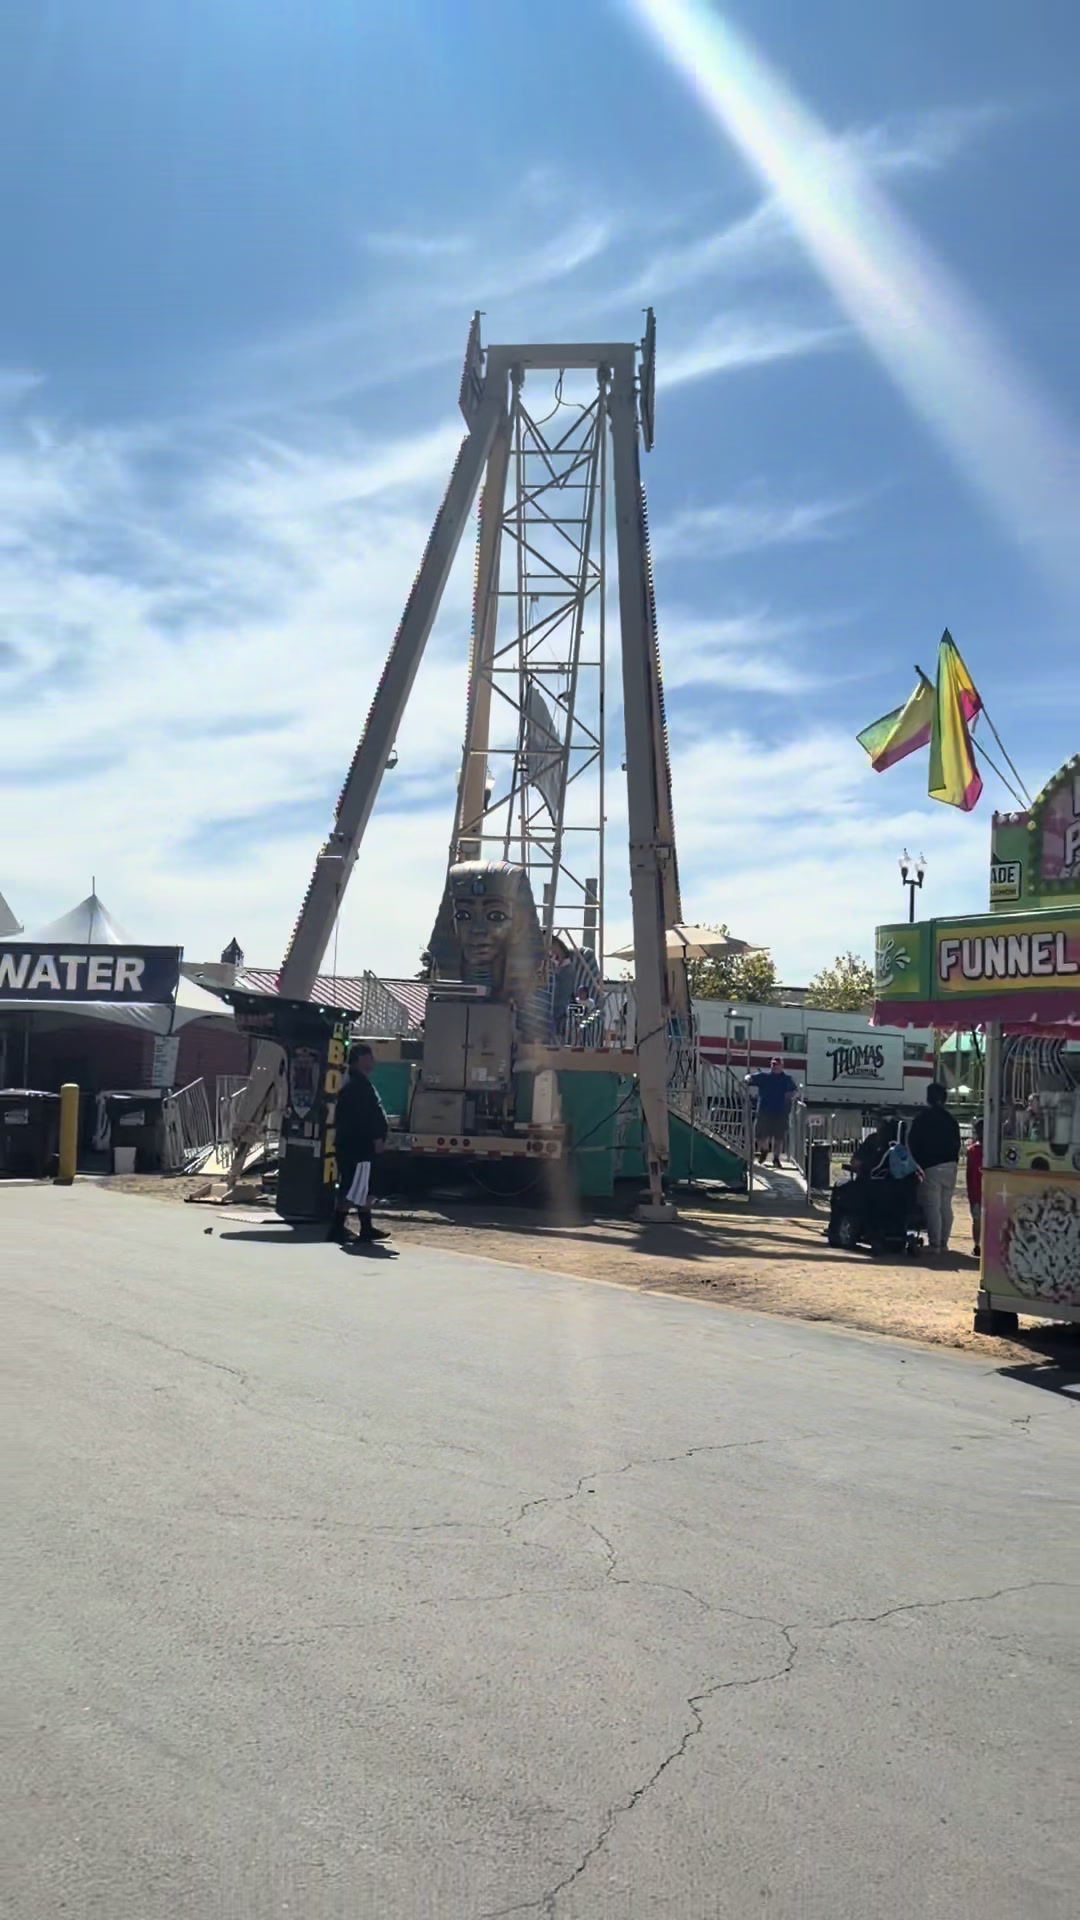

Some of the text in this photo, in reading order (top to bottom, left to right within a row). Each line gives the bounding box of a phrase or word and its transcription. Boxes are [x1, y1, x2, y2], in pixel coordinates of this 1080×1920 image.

[0, 953, 146, 992] WATER
[939, 931, 1080, 982] FUNNEL
[826, 1045, 885, 1081] THOMAS
